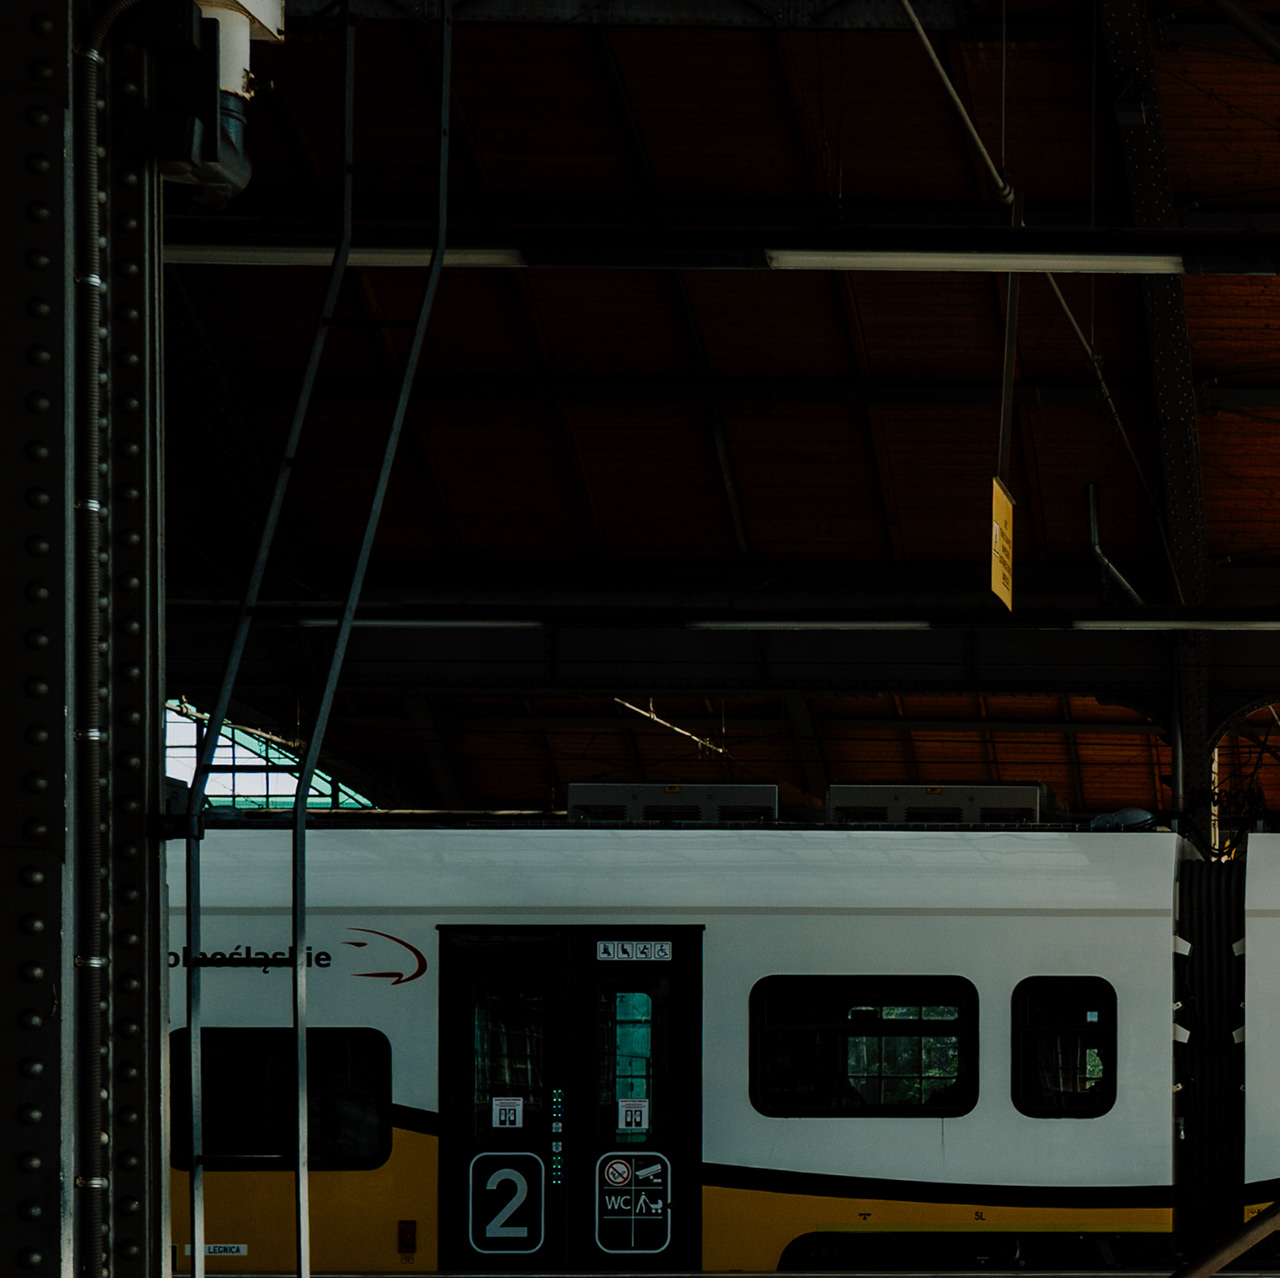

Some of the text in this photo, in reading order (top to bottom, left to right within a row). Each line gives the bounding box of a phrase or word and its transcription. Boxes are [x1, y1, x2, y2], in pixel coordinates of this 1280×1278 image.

[486, 1168, 528, 1237] 2
[605, 1195, 631, 1210] WC
[974, 1211, 986, 1221] 5L
[208, 1245, 242, 1255] LEGNICA
